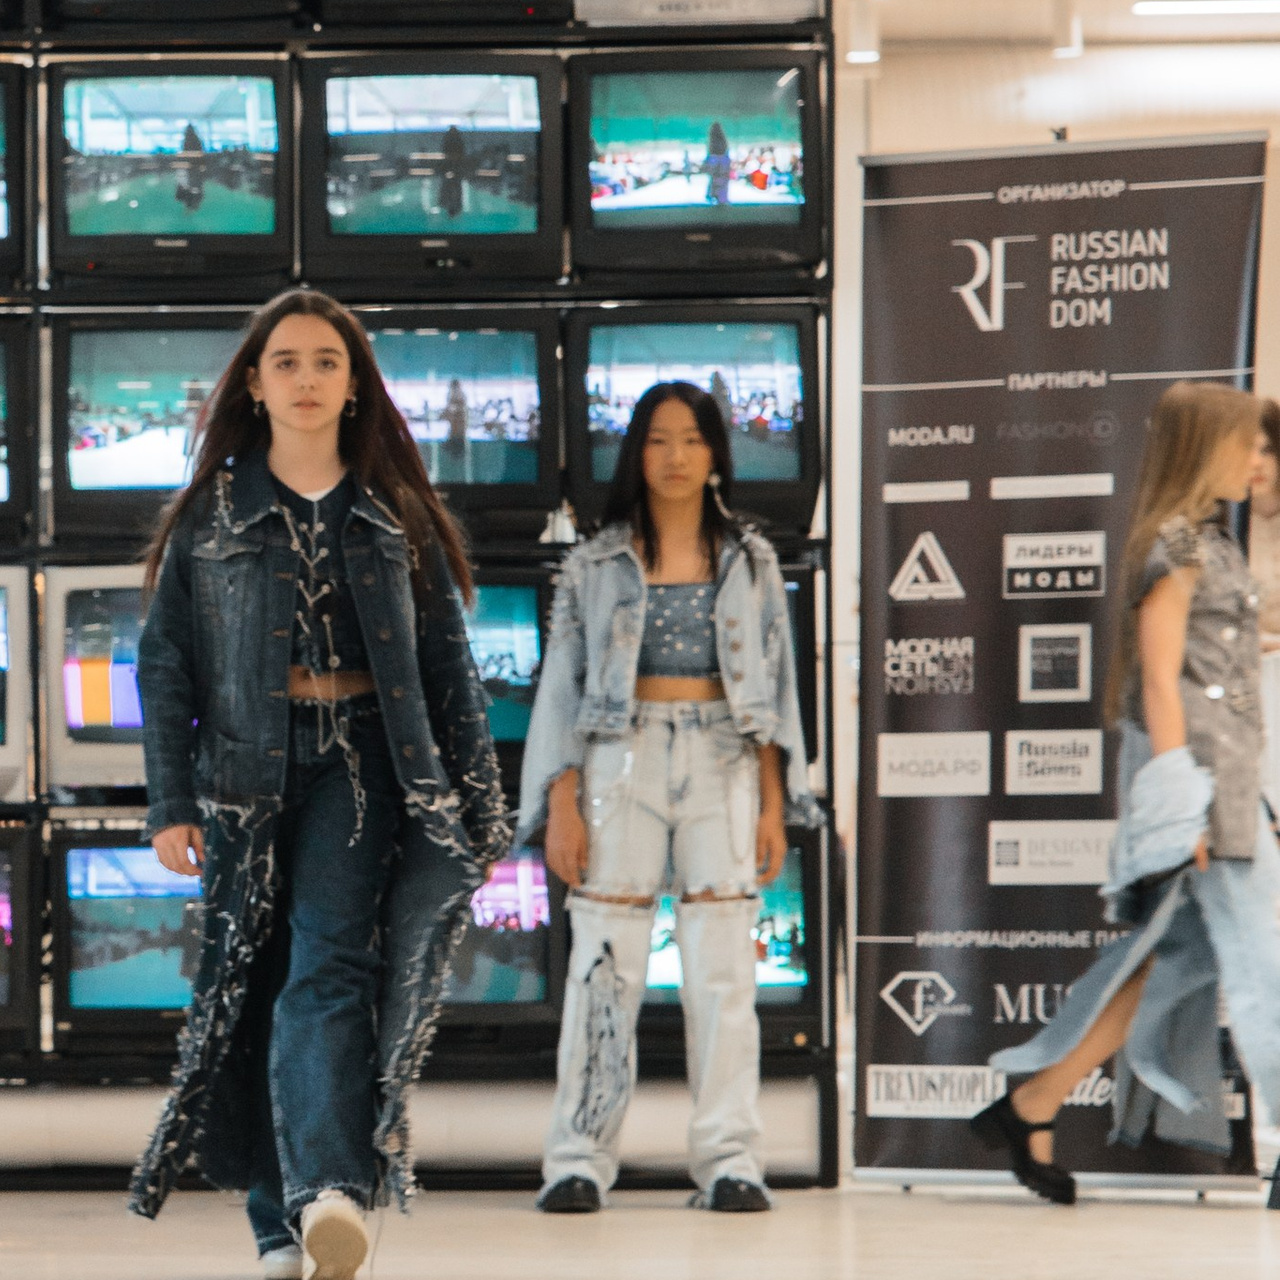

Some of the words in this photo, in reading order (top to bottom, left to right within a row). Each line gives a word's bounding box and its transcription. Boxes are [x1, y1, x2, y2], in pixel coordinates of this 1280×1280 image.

[998, 179, 1126, 205] ОРГАНИЗАТОР
[1050, 228, 1169, 261] RUSSIAN
[1050, 262, 1170, 295] FASHION
[1050, 298, 1111, 329] DOM
[1008, 370, 1107, 392] ПАРТНЕРЫ
[888, 424, 975, 447] MODA.RU
[1014, 543, 1094, 562] ЛИДЕРЫ
[1013, 568, 1096, 590] МОДЫ
[885, 637, 975, 658] МОДНАЯ
[885, 657, 938, 678] СЕТЬ
[887, 757, 983, 778] МОДА.РФ
[916, 930, 1091, 951] ИНФОРМАЦИОННЫЕ
[994, 982, 1073, 1024] MU
